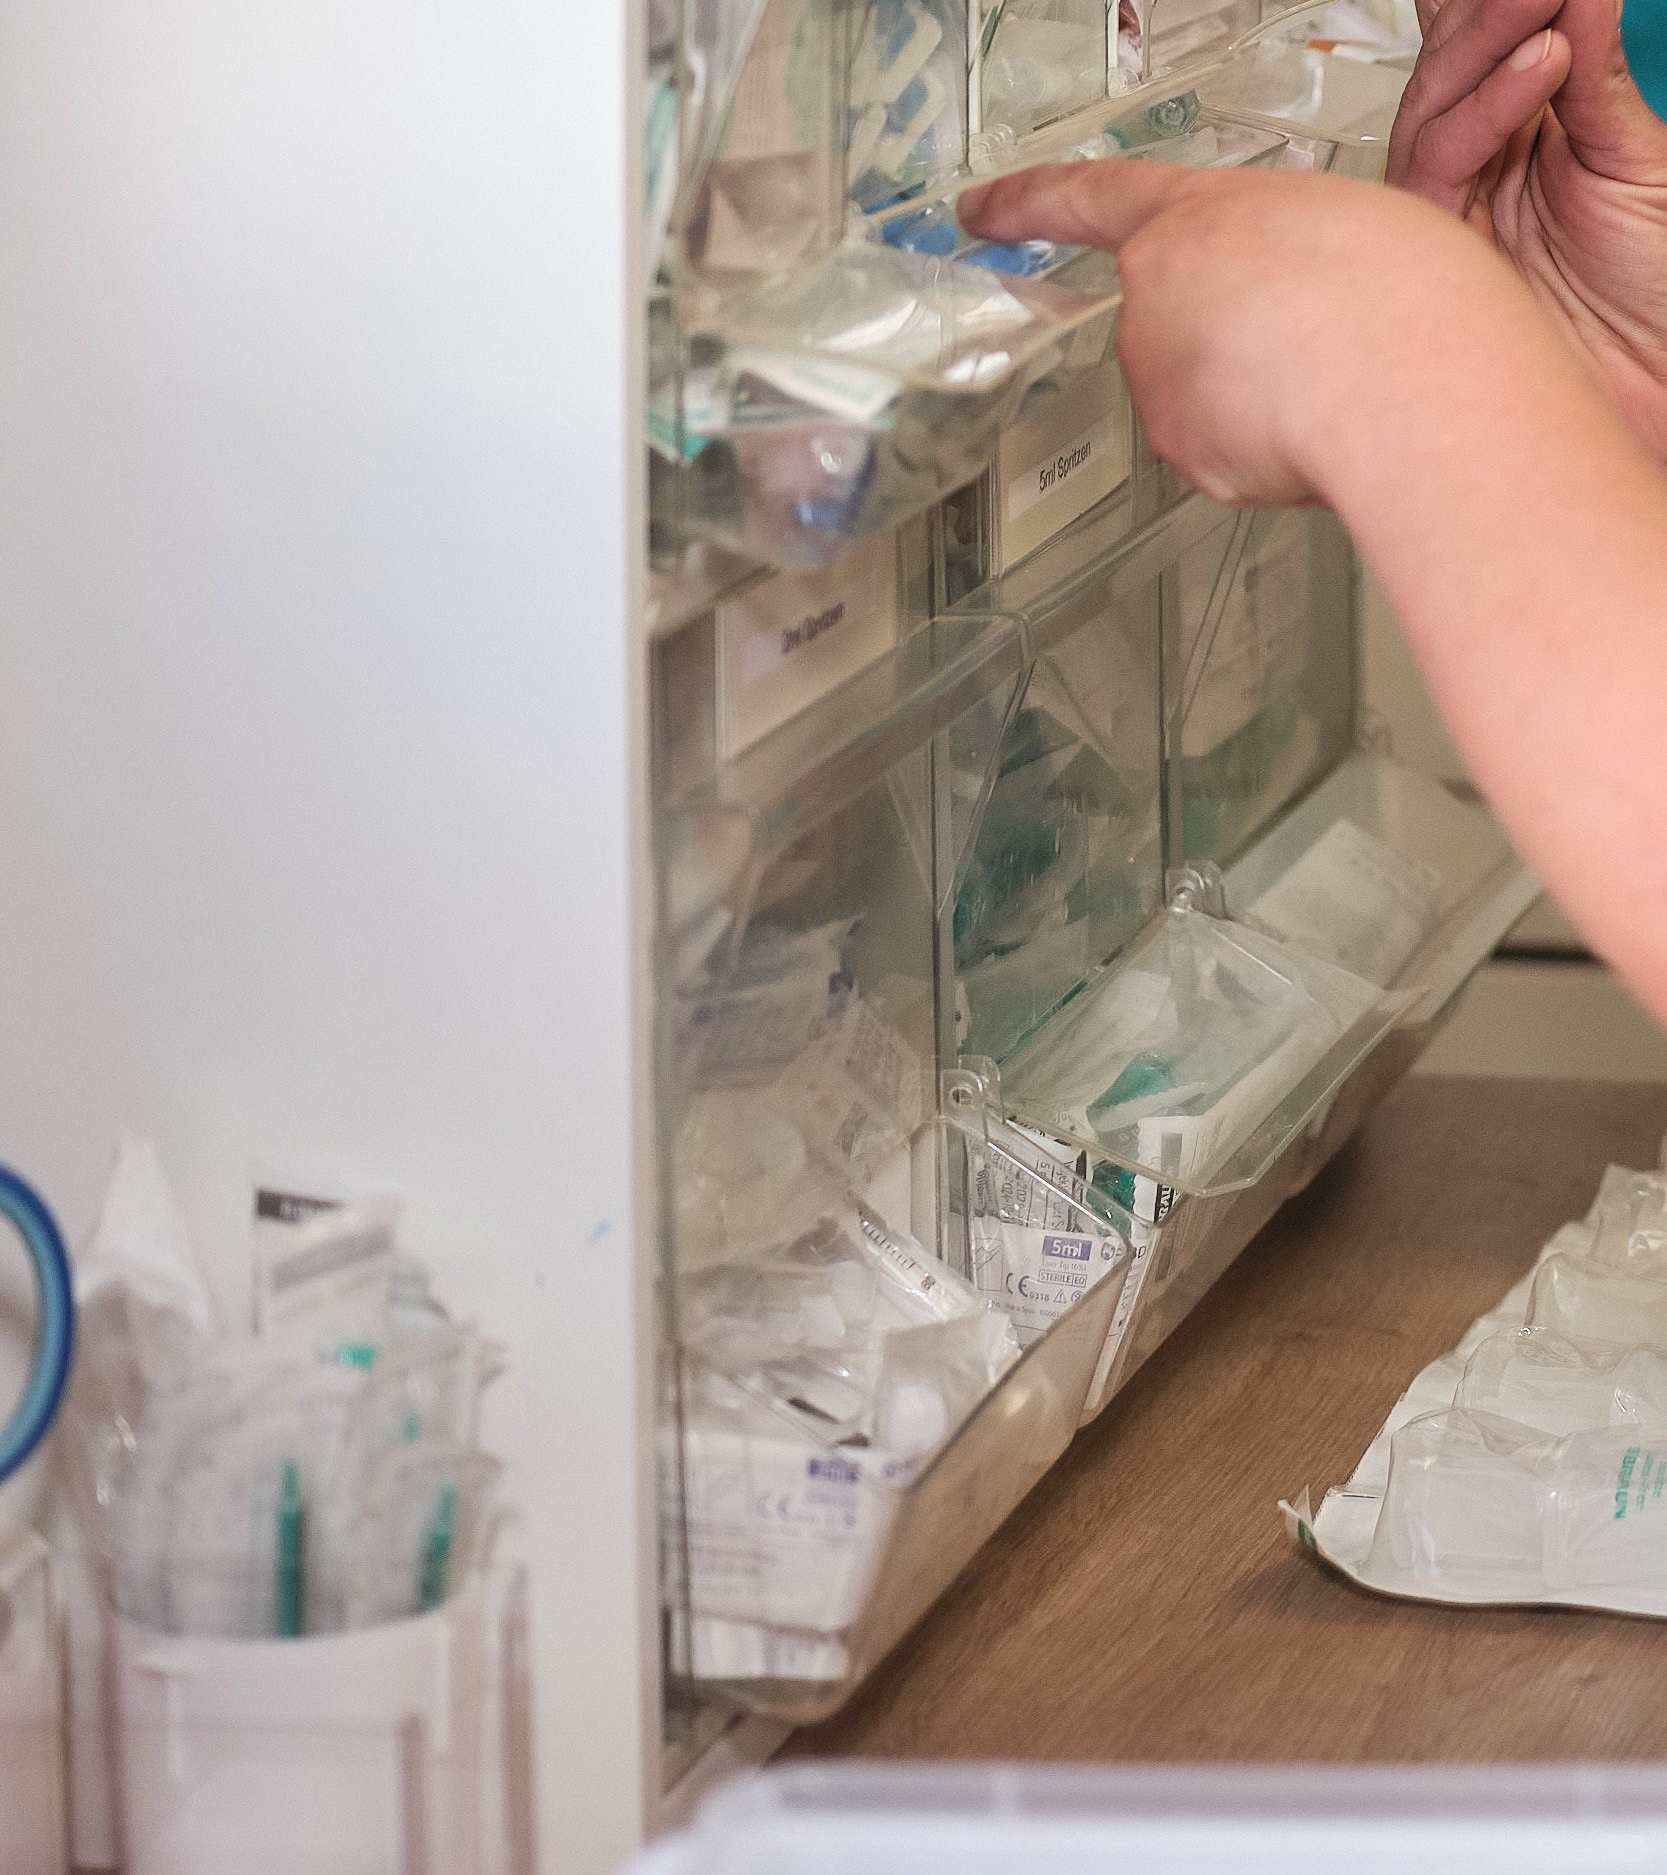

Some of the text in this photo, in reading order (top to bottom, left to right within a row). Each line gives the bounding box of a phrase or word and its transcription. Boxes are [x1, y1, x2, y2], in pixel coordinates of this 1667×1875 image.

[1039, 440, 1091, 491] 5ml Spritzen
[1051, 1239, 1082, 1258] 5ml
[1040, 1272, 1072, 1284] STERILE
[1030, 1291, 1050, 1302] 0318
